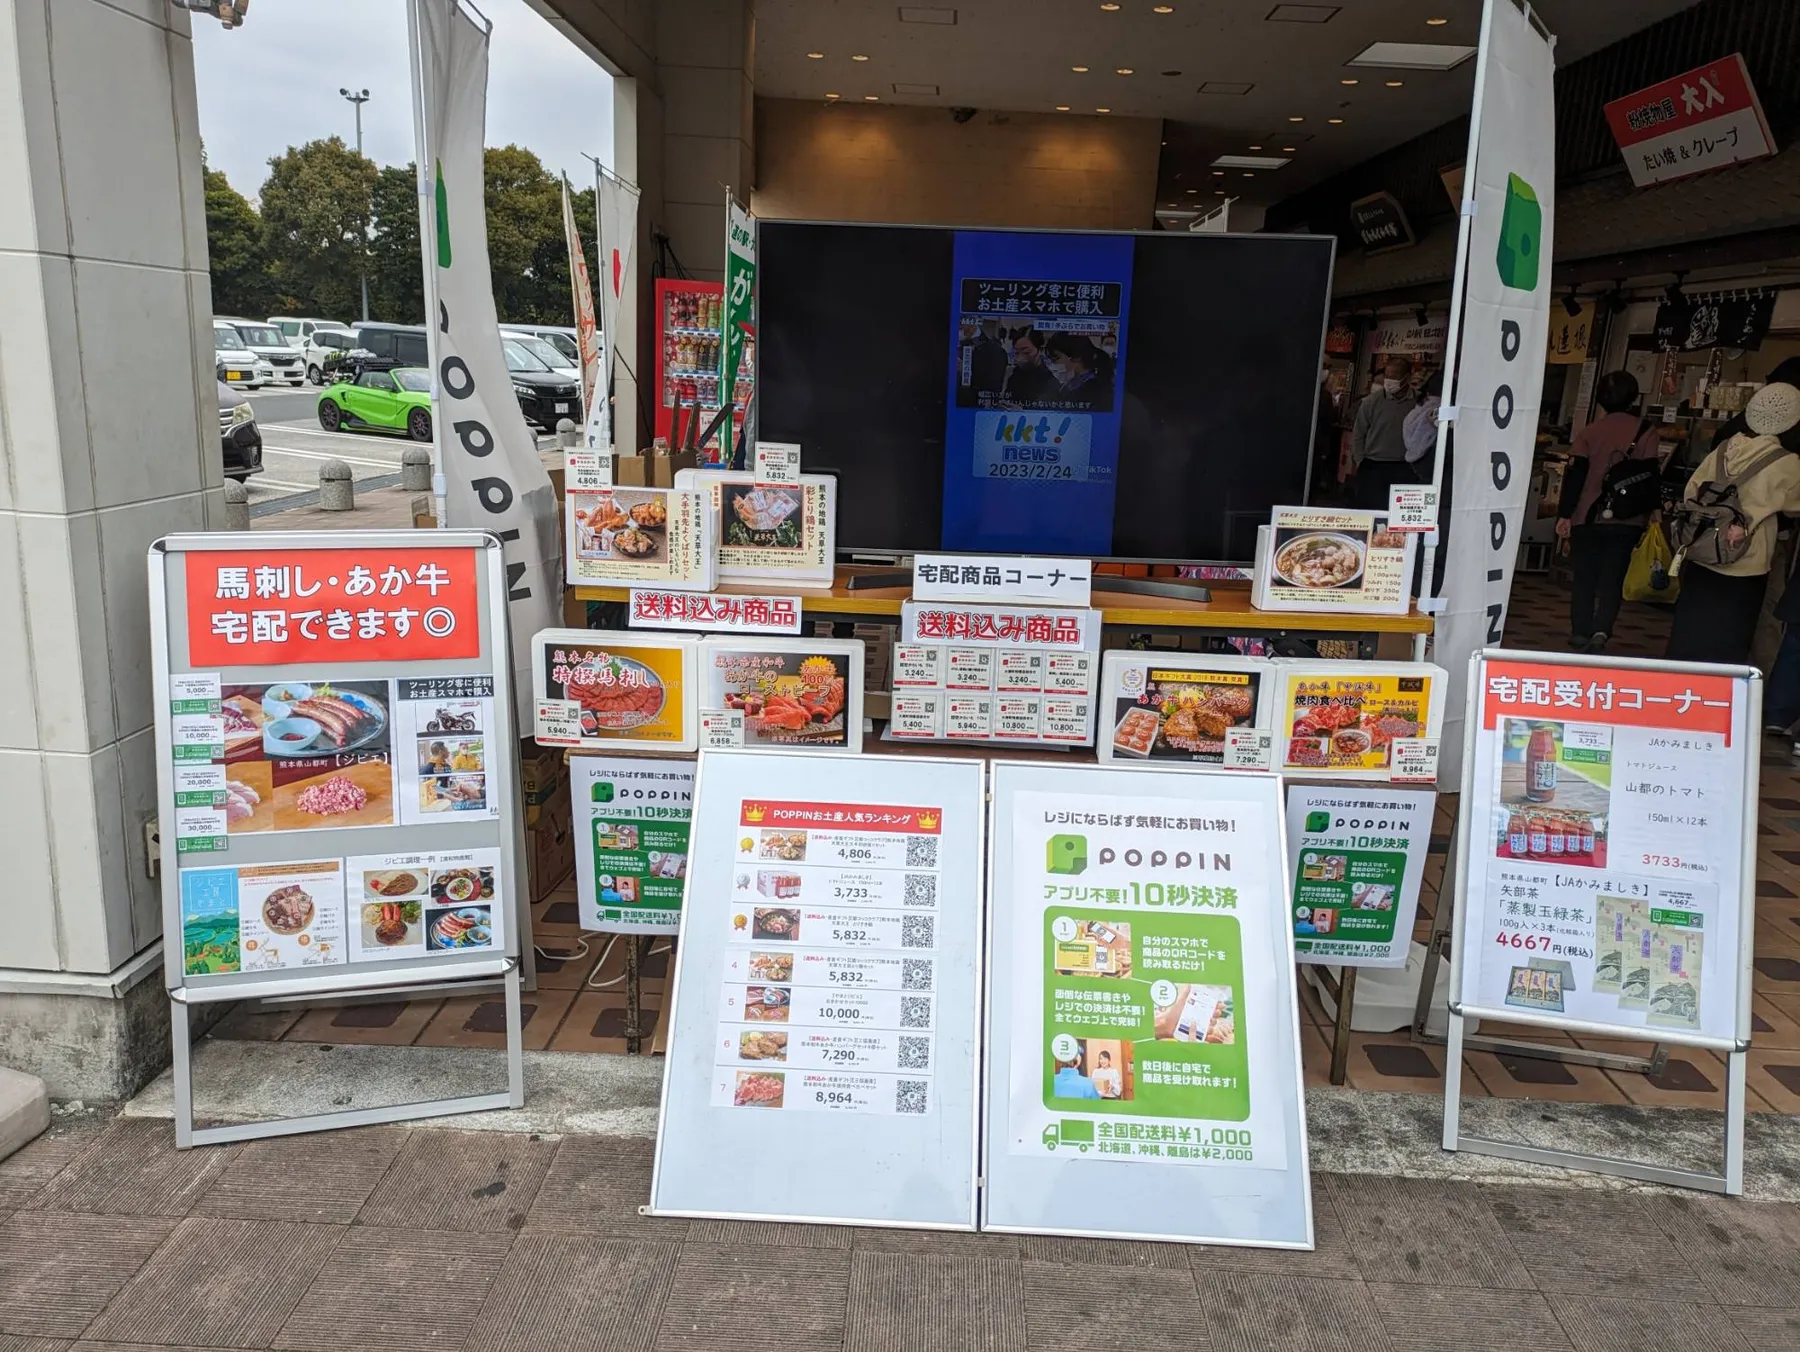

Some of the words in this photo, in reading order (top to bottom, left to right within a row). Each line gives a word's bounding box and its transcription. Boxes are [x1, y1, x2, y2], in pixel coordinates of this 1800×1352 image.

[1643, 147, 1677, 171] たい焼
[1680, 146, 1690, 159] &
[1693, 127, 1738, 156] クレープ
[979, 283, 1104, 300] ツーリング客に便利
[978, 298, 1103, 315] お土産スマホで購入
[995, 415, 1072, 444] kkt!
[1002, 445, 1060, 463] news
[989, 463, 1072, 479] 2023/2/24
[818, 484, 826, 527] 熊本の地鶏
[805, 486, 816, 550] 彩とり鶏セット
[681, 492, 690, 580] 大手羽先よくばりセット
[215, 564, 451, 599] 馬刺し・あか牛
[918, 564, 1087, 587] 宅配商品コーナー
[634, 592, 798, 626] 送料込み商品
[917, 611, 1081, 644] 送料込み商品
[552, 650, 610, 664] 熊本名物
[410, 678, 492, 689] ツーリング客に便利
[724, 670, 778, 684] あか牛の
[410, 688, 492, 698] お土産スマホで購入
[738, 684, 831, 697] ローストビーフ
[1488, 675, 1731, 715] 宅配受付コーナー
[1137, 693, 1250, 710] あか牛ハンバーグ
[1294, 694, 1367, 706] 焼肉食べ比べ
[1648, 738, 1713, 751] JAかみましき
[279, 760, 328, 768] 熊本県山都町
[335, 752, 388, 767] 【ジビエ】
[1626, 761, 1677, 771] トマトジュース
[620, 789, 691, 800] POPPIN
[1626, 783, 1705, 798] 山都のトマト
[773, 809, 911, 825] POPPINお土産人気ランキング
[1044, 810, 1236, 832] レジにならばず気軽にお買い物!
[1335, 819, 1410, 830] POPPIN
[1301, 836, 1410, 849] アプリ不要!10秒決済
[384, 855, 436, 865] ジビエ調理一例
[838, 848, 872, 860] 4,806
[1099, 847, 1231, 871] POPPIN
[1500, 873, 1548, 884] 熊本県山都町
[1552, 875, 1651, 897] 【JAかみましき】
[1500, 885, 1539, 899] 矢部茶
[834, 887, 868, 899] 3,733
[1043, 882, 1238, 909] アプリ不要!10秒決済
[1499, 899, 1593, 925] 「蒸製玉緑茶」
[1062, 921, 1068, 932] 1
[832, 929, 866, 942] 5,832
[1143, 936, 1208, 948] 自分のスマホで
[1143, 947, 1226, 960] 商品のQRコードを
[1143, 959, 1205, 971] 読み取るだけ!
[828, 971, 863, 983] 5,832
[1055, 989, 1131, 1002] 面倒な伝票書きや
[1160, 986, 1168, 996] 2
[728, 998, 734, 1006] 5
[1055, 1002, 1145, 1016] レジでの決済は不要!
[818, 1008, 860, 1020] 10,000
[1055, 1014, 1141, 1027] 全てウェブ上で完結!
[724, 1040, 730, 1048] 6
[1060, 1040, 1069, 1051] 3
[821, 1049, 855, 1062] 7,290
[1142, 1060, 1211, 1073] 数日後に自宅で
[1143, 1073, 1237, 1088] 商品を受け取れます!
[815, 1091, 852, 1104] 8,964
[1098, 1122, 1252, 1146] 全国配送料¥1,000
[1098, 1141, 1253, 1161] 北海道、沖縄、離島は¥2,000
